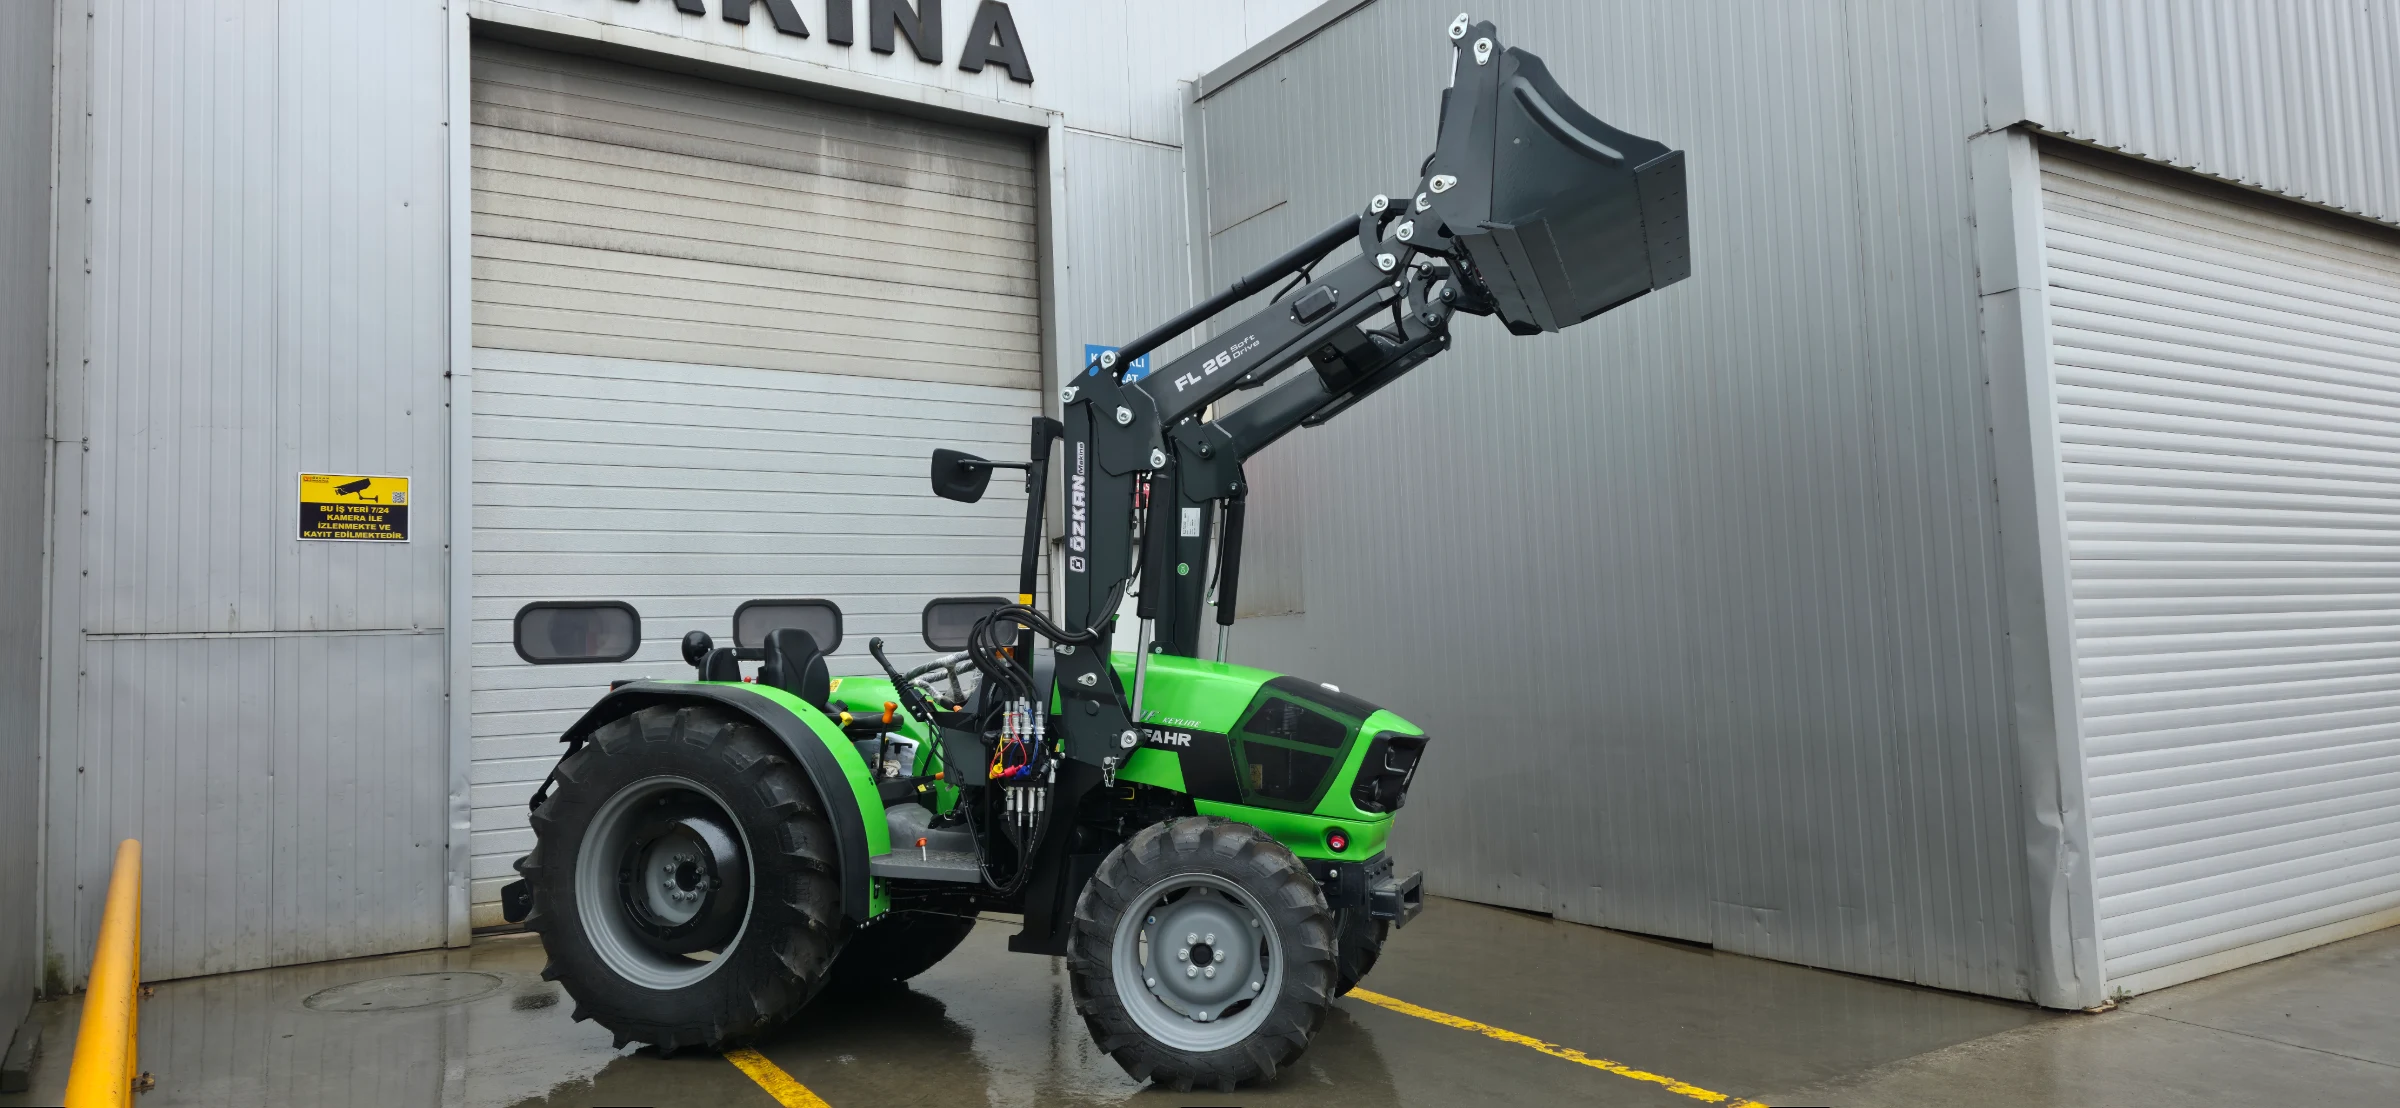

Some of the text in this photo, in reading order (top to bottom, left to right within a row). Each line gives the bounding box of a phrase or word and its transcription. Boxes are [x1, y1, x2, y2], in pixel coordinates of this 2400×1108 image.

[1230, 334, 1255, 353] Soft
[1232, 340, 1260, 359] Drive
[1174, 350, 1231, 392] FL 26
[335, 504, 345, 514] İŞ
[347, 505, 369, 513] YERİ
[371, 506, 389, 514] 7/24
[1070, 475, 1086, 553] ÖZKAN
[326, 514, 383, 522] KAMERA İLE
[317, 522, 377, 530] İZLENMEKTE
[303, 530, 404, 539] KAYIT EDİLMEKTEDİR.
